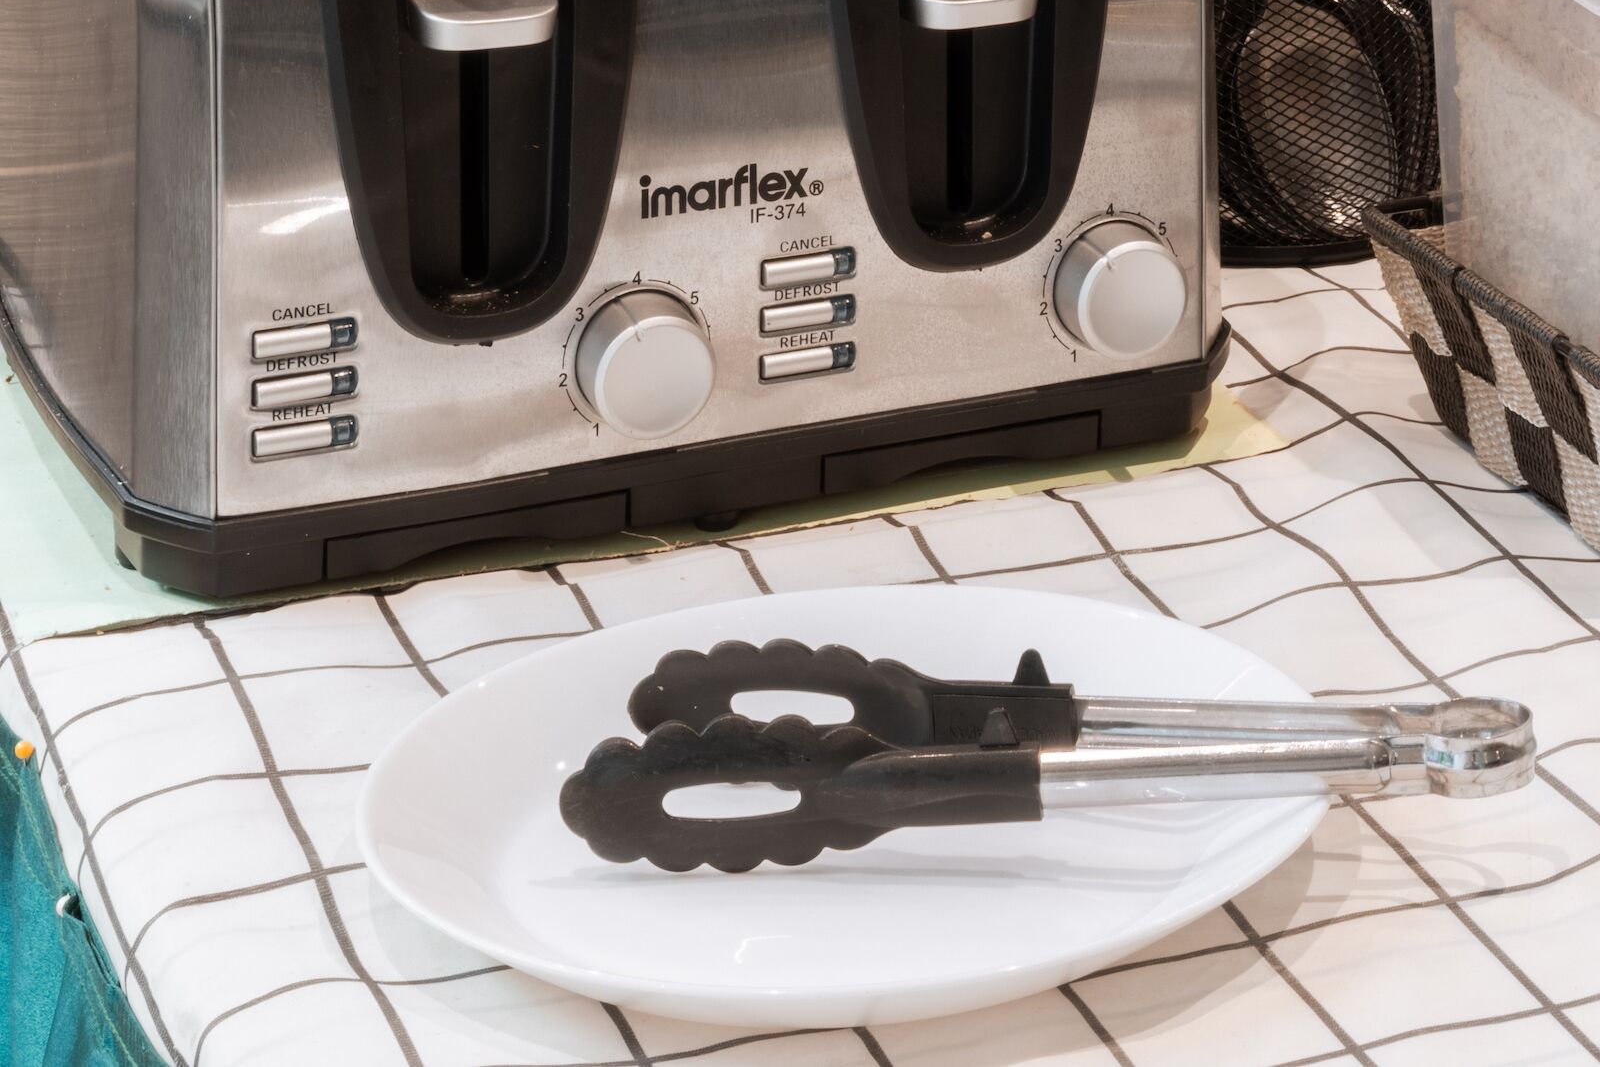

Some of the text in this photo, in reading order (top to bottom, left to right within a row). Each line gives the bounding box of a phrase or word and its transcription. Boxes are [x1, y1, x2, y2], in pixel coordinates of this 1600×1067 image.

[750, 202, 806, 224] IF-374
[1105, 203, 1115, 216] 4
[1158, 222, 1167, 236] 5
[779, 235, 837, 253] CANCEL
[1054, 238, 1063, 253] 3
[632, 271, 642, 285] 4
[690, 291, 699, 305] 5
[774, 281, 841, 302] DEFROST
[272, 302, 335, 322] CANCEL
[575, 307, 585, 322] 3
[1039, 301, 1048, 316] 2
[779, 330, 836, 349] REHEAT
[266, 351, 338, 373] DEFROST
[1070, 349, 1077, 363] 1
[558, 373, 568, 388] 2
[272, 402, 333, 422] REHEAT
[592, 422, 600, 437] 1
